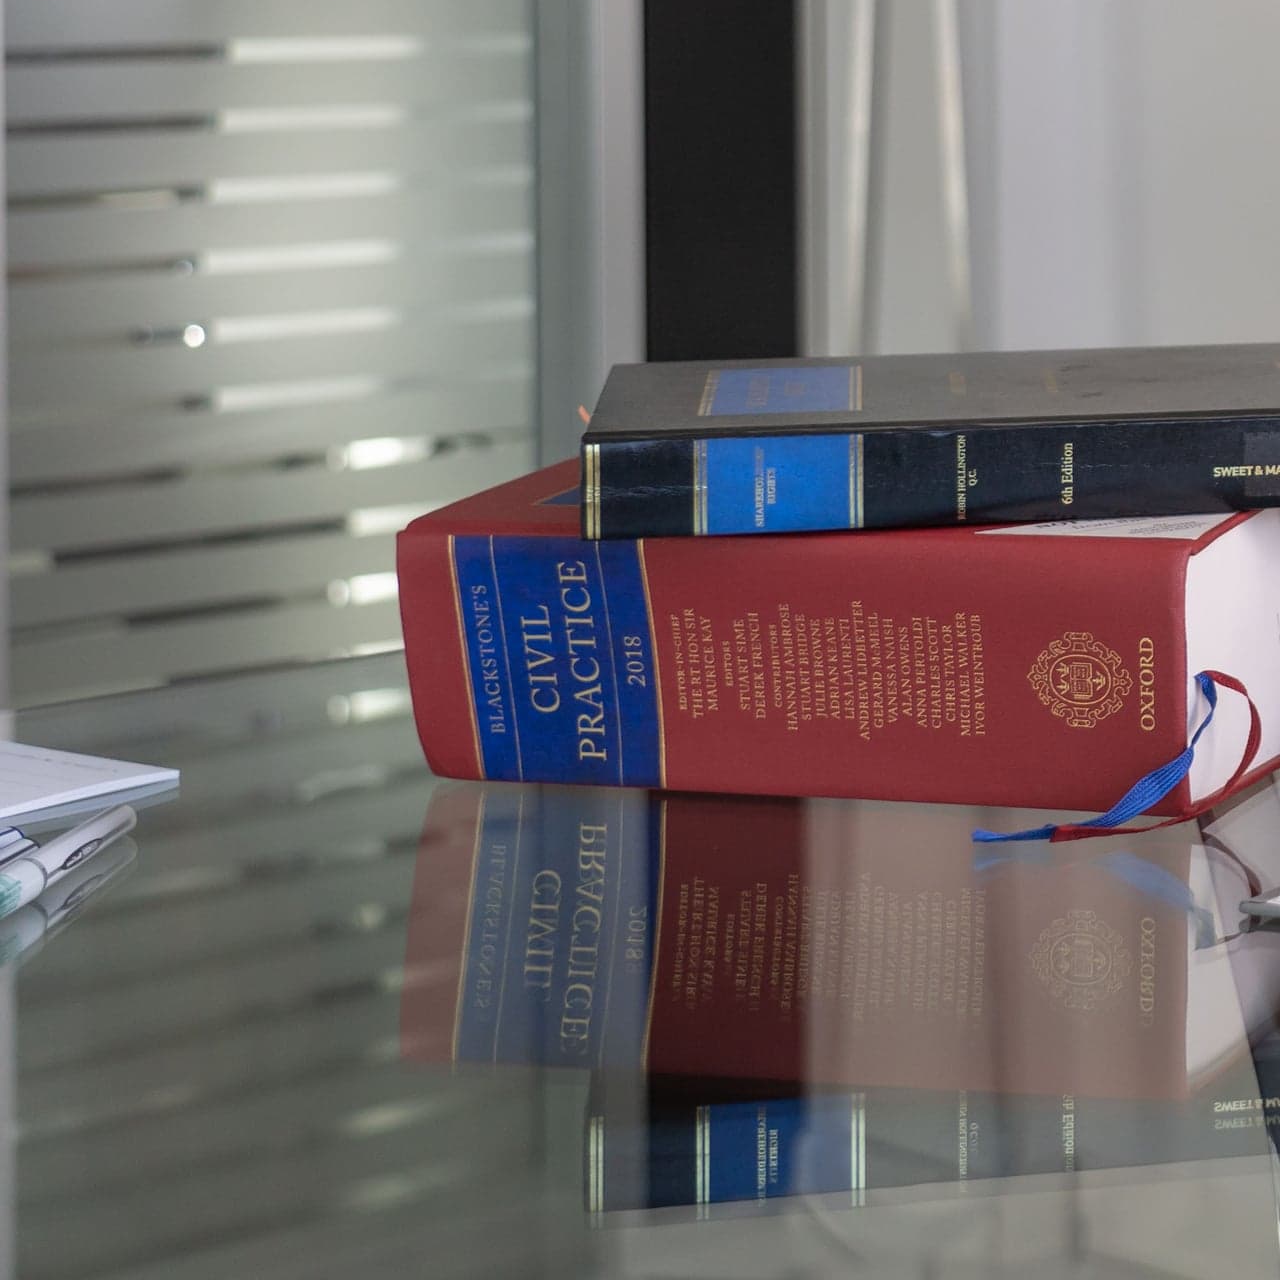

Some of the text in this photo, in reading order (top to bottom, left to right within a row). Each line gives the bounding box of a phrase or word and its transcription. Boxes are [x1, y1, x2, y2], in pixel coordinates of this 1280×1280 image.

[957, 435, 966, 491] HOLLINGTON
[969, 469, 977, 486] Q.C.
[1061, 443, 1073, 504] 6th Edition
[1214, 466, 1254, 477] SWEET
[1255, 465, 1263, 475] &
[472, 585, 506, 733] BLACKSTONE'S
[521, 605, 560, 713] CIVIL
[557, 560, 607, 760] PRACTICE
[624, 636, 646, 687] 2018
[671, 613, 688, 711] EDITOR-IN-CHIEF
[684, 608, 704, 718] THE RT HON SIR
[701, 616, 719, 711] MAURICE KAY
[722, 640, 733, 687] EDITORS
[734, 618, 751, 711] STUART SIME
[748, 612, 766, 719] DEREK FRENCH
[769, 624, 782, 708] CONTRIBUTORS
[779, 603, 799, 731] HANNAH AMBROSE
[795, 613, 812, 721] STUART BRIDGE
[810, 618, 826, 718] JULIE BROWNE
[824, 617, 840, 720] ADRIAN KEANE
[839, 617, 855, 720] LISA LAURENTI
[852, 600, 870, 740] ANDREW LIDBETTER
[867, 612, 884, 729] GERARD McMEEL
[882, 618, 898, 723] VANESSA NAISH
[898, 626, 912, 717] ALAN OWENS
[911, 616, 927, 728] ANNA PERTOLDI
[926, 616, 941, 729] CHARLES SCOTT
[941, 624, 956, 722] CHRIS TAYLOR
[955, 612, 971, 736] MICHAEL WALKER
[970, 614, 986, 736] IVOR WEINTROUB
[1138, 638, 1156, 730] OXFORD
